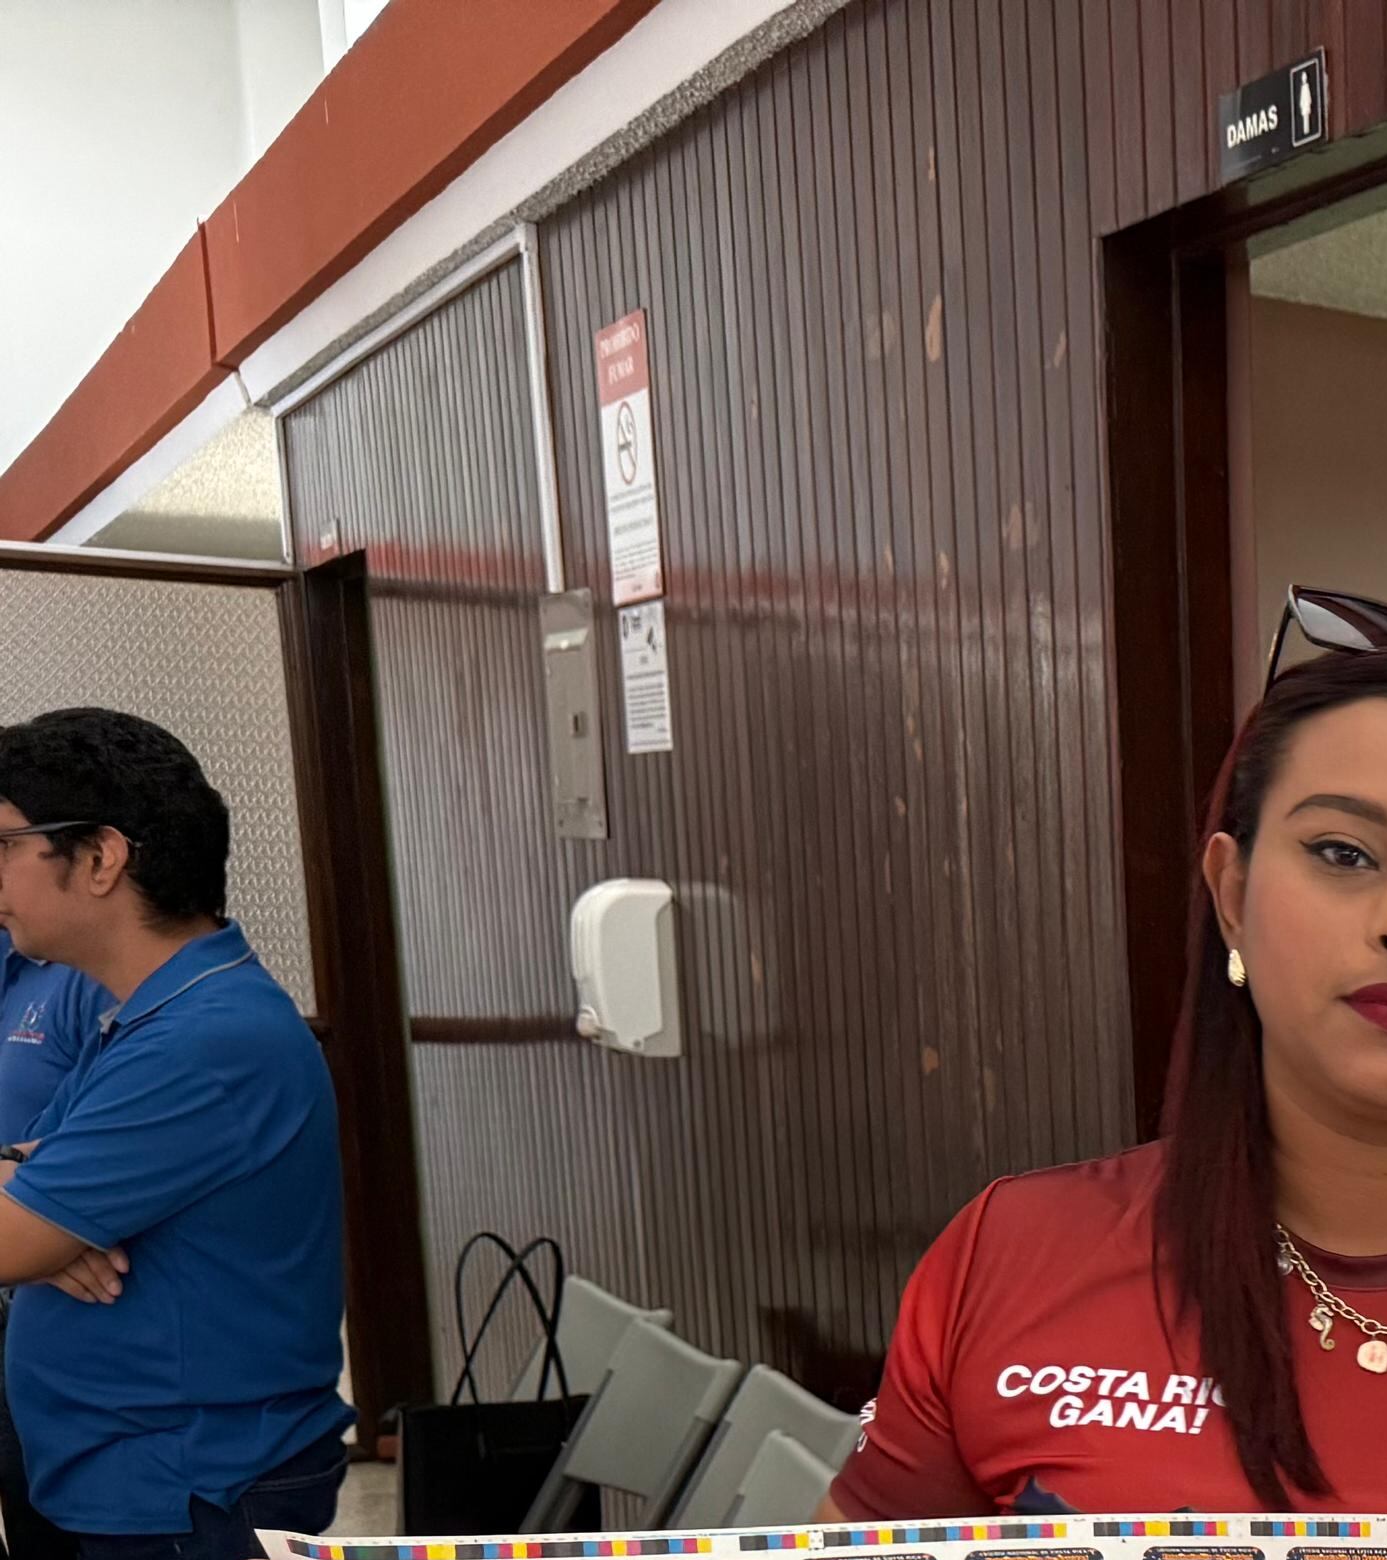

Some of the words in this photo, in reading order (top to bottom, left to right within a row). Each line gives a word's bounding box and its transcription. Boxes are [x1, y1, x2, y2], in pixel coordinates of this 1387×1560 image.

[1226, 104, 1278, 148] DAMAS
[996, 1364, 1151, 1401] COSTA
[1049, 1395, 1210, 1435] GANA!
